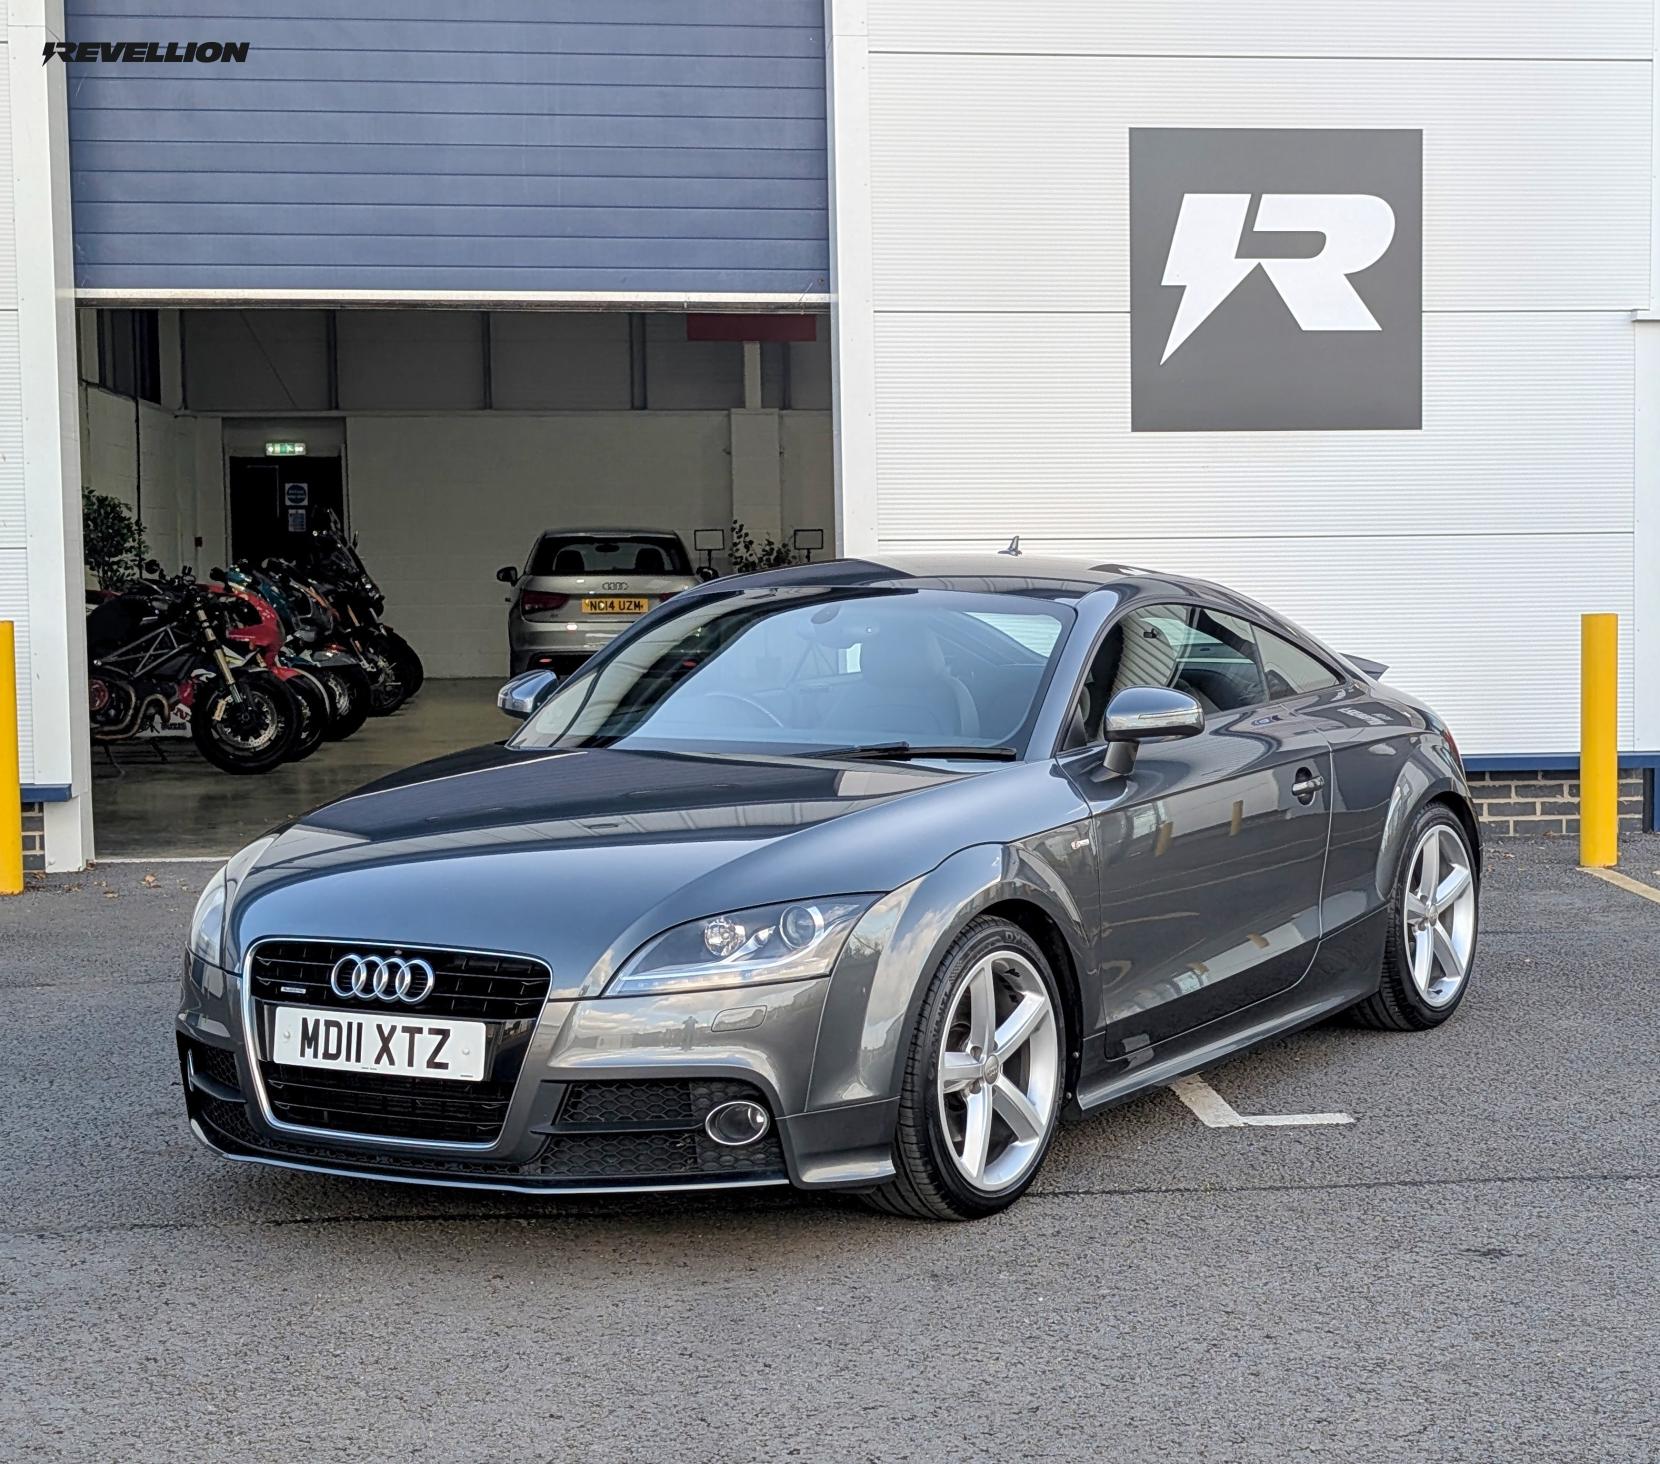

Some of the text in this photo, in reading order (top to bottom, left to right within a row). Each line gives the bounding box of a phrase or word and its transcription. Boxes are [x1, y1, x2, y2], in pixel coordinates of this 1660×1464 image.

[589, 600, 641, 611] NC14 UZM
[300, 1016, 451, 1071] MD11 XTZ
